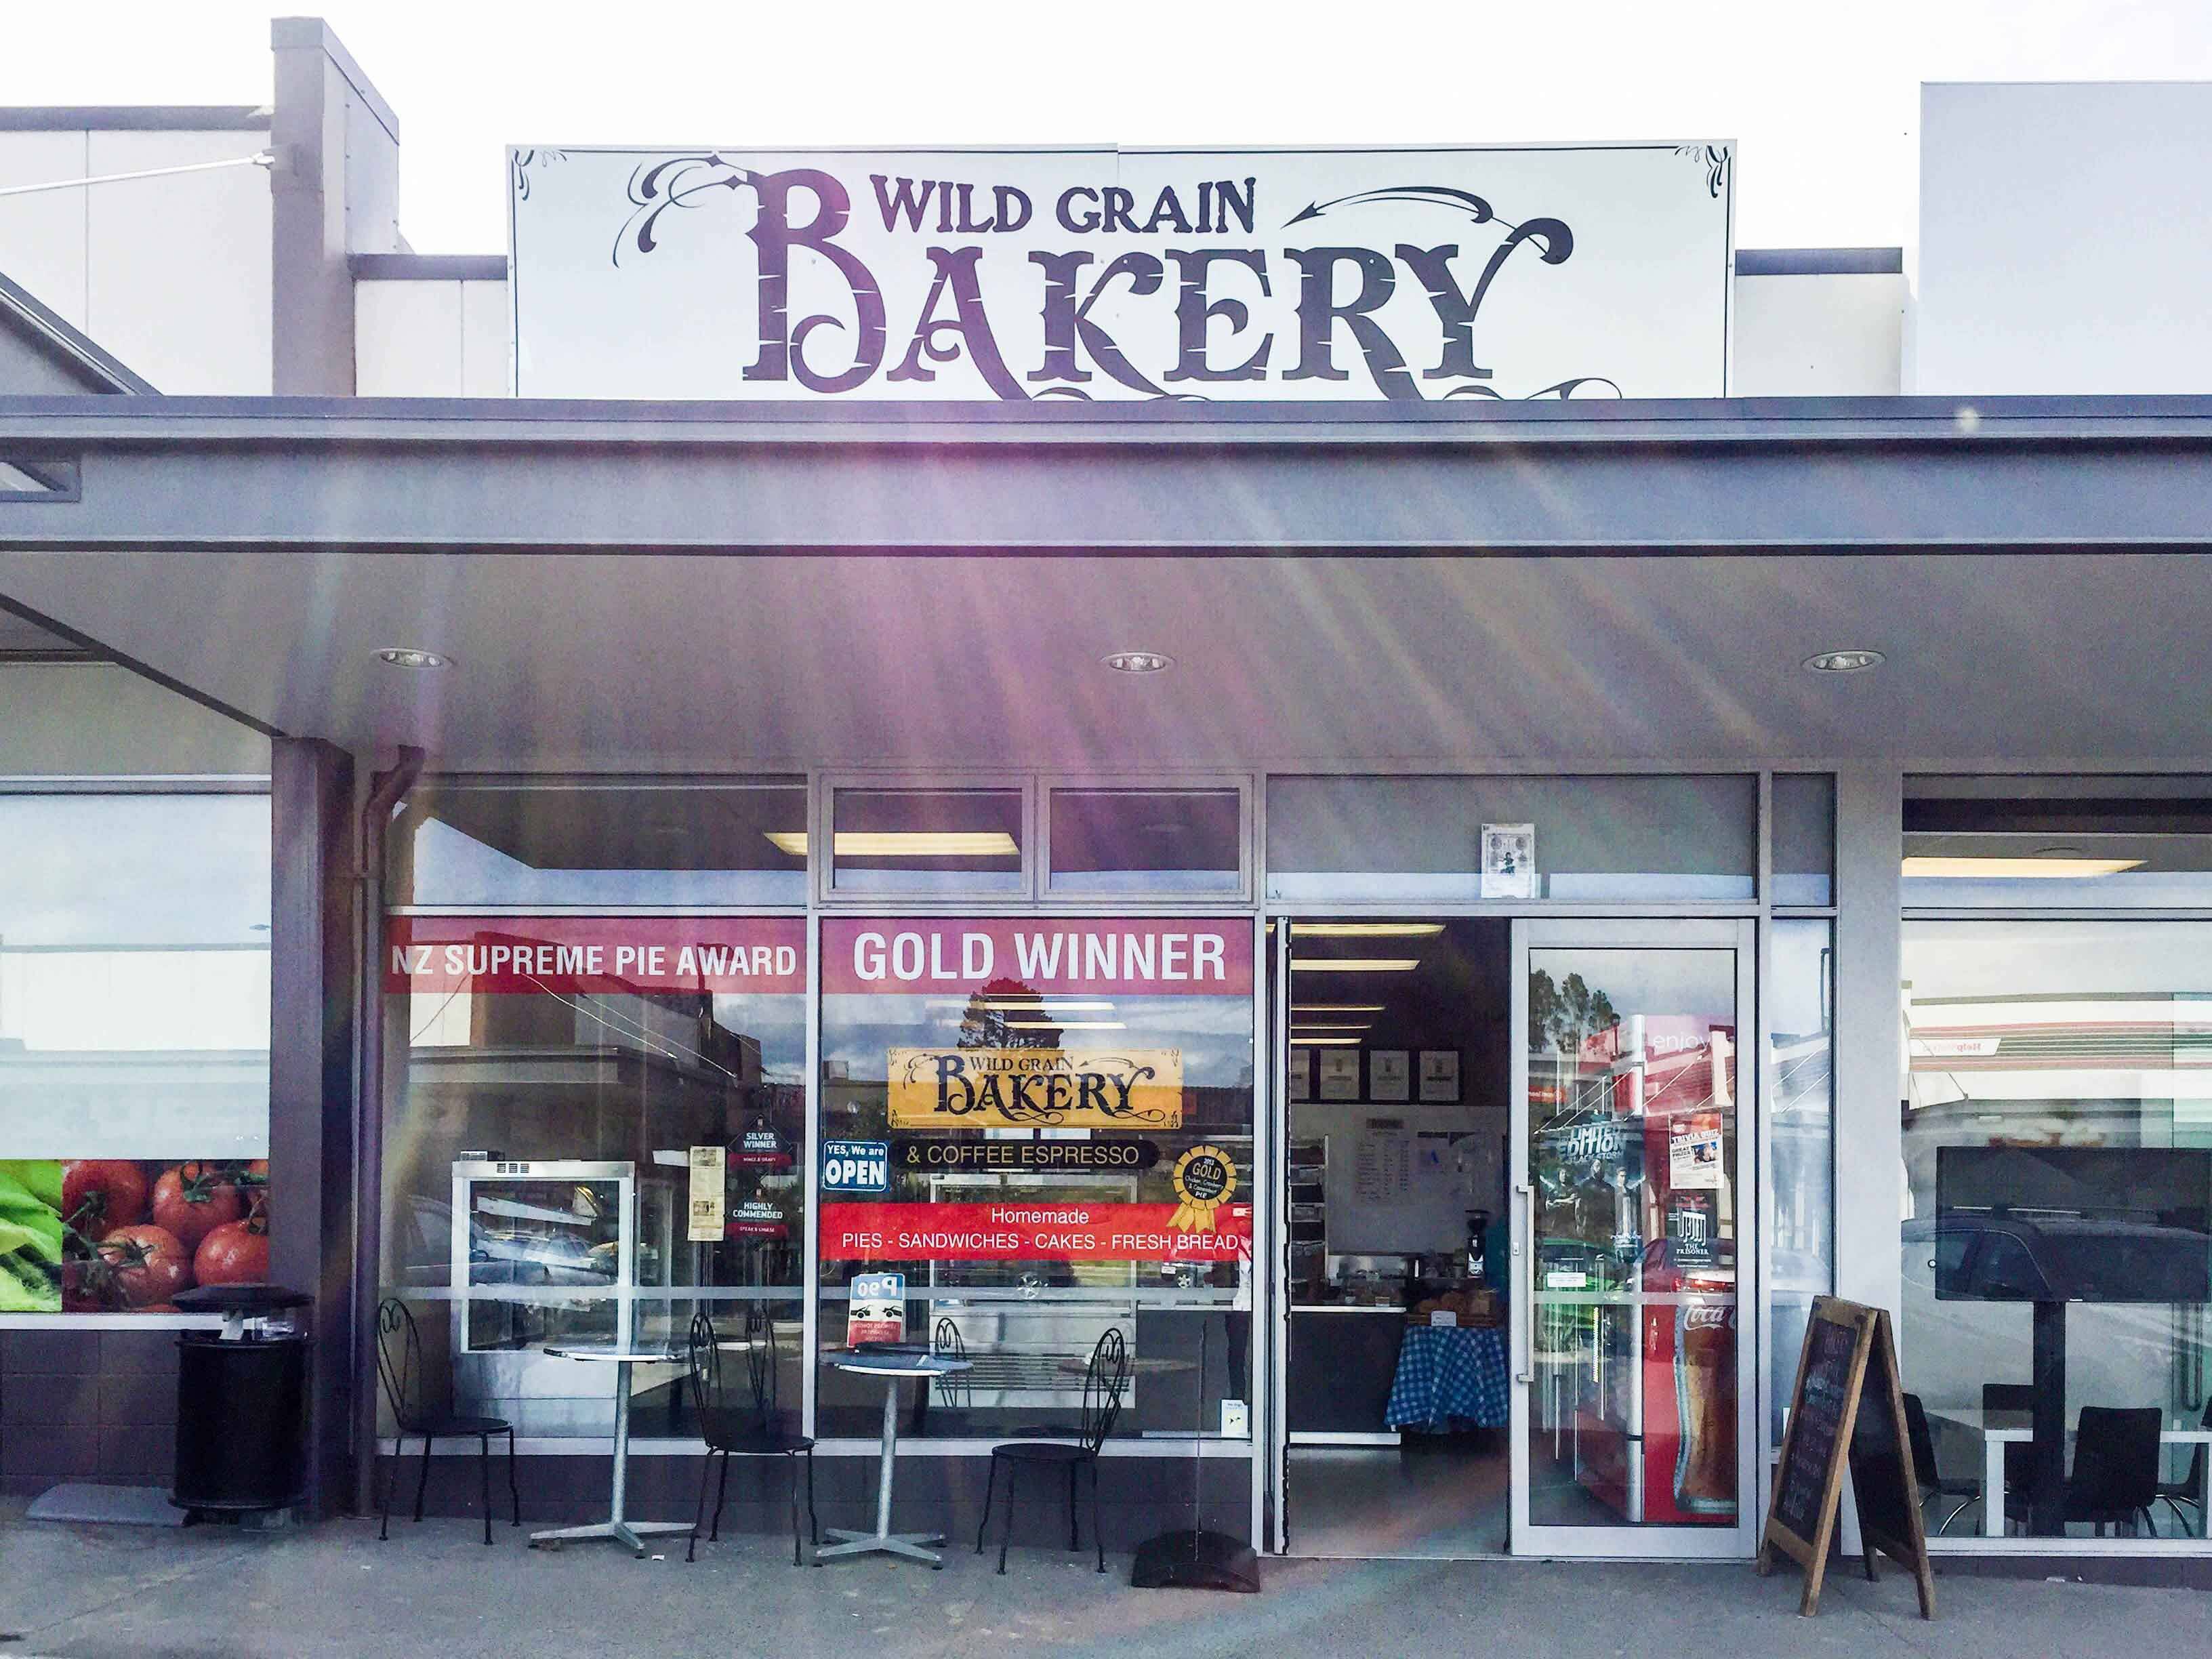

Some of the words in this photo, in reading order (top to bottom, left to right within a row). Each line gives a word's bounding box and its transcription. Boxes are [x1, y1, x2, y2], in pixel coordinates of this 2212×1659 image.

[869, 174, 1033, 234] WILD
[1055, 175, 1256, 234] GRAIN
[742, 168, 1574, 400] BAKERY
[392, 945, 434, 975] NZ
[445, 945, 605, 976] SUPREME
[616, 946, 666, 976] PIE
[676, 946, 797, 976] AWARD
[853, 931, 994, 981] GOLD
[1014, 933, 1226, 981] WINNER
[970, 1055, 1014, 1071] WILD
[1018, 1055, 1074, 1071] GRAIN
[933, 1054, 1155, 1120] BAKERY
[743, 1141, 777, 1149] WINNER
[746, 1132, 775, 1141] SILVER
[826, 1145, 849, 1156] YES,
[851, 1145, 867, 1155] We
[869, 1147, 884, 1157] are
[907, 1145, 920, 1164] &
[927, 1145, 1015, 1164] COFFEE
[1021, 1145, 1140, 1165] ESPRESSO
[824, 1159, 885, 1185] OPEN
[1192, 1162, 1221, 1180] GOLD
[733, 1210, 783, 1219] COMMENDED
[744, 1202, 773, 1211] HIGHLY
[991, 1208, 1090, 1225] Homemade
[842, 1233, 882, 1248] PIES
[898, 1233, 1019, 1249] SANDWICHES
[1034, 1233, 1096, 1250] CAKES
[1111, 1234, 1172, 1250] FRESH
[1176, 1234, 1239, 1250] BREAD
[1683, 1303, 1725, 1331] Coca
